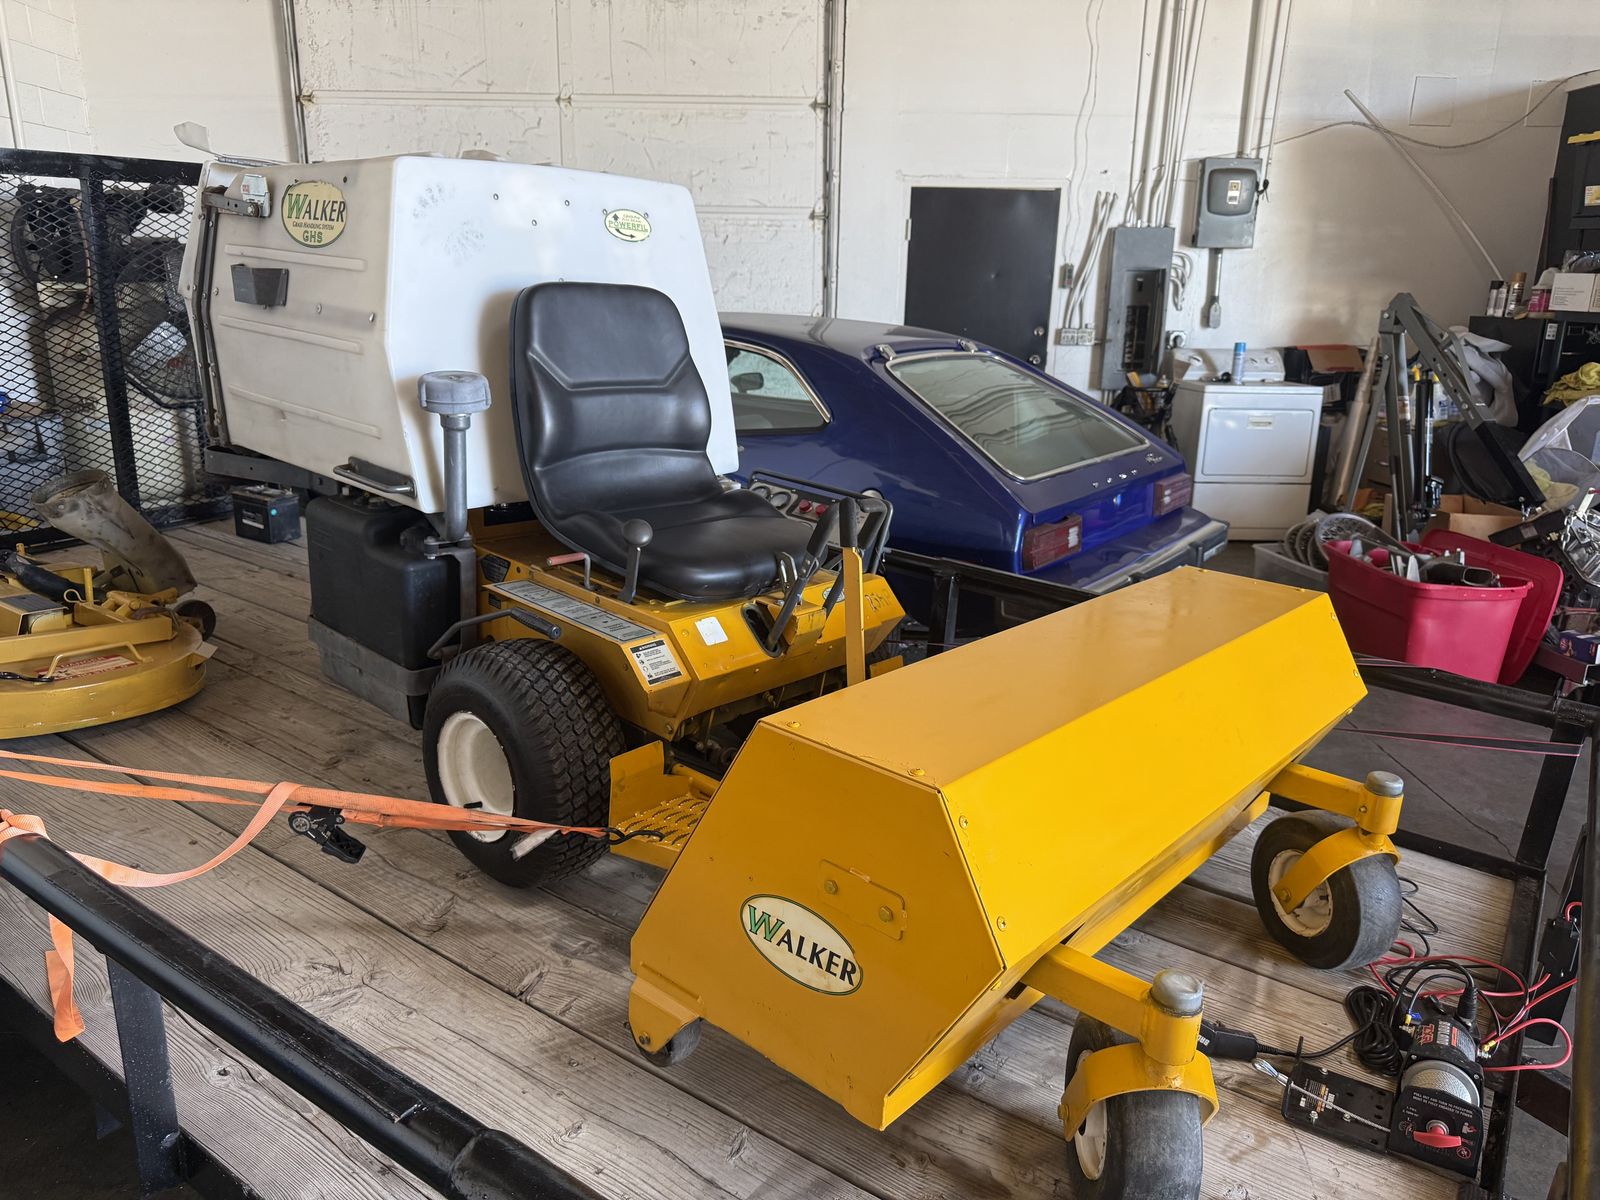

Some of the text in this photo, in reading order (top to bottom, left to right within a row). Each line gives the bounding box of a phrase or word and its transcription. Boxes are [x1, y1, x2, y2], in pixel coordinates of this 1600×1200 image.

[287, 193, 346, 222] WALKER
[302, 230, 323, 244] GHS
[747, 904, 857, 986] WALKER
